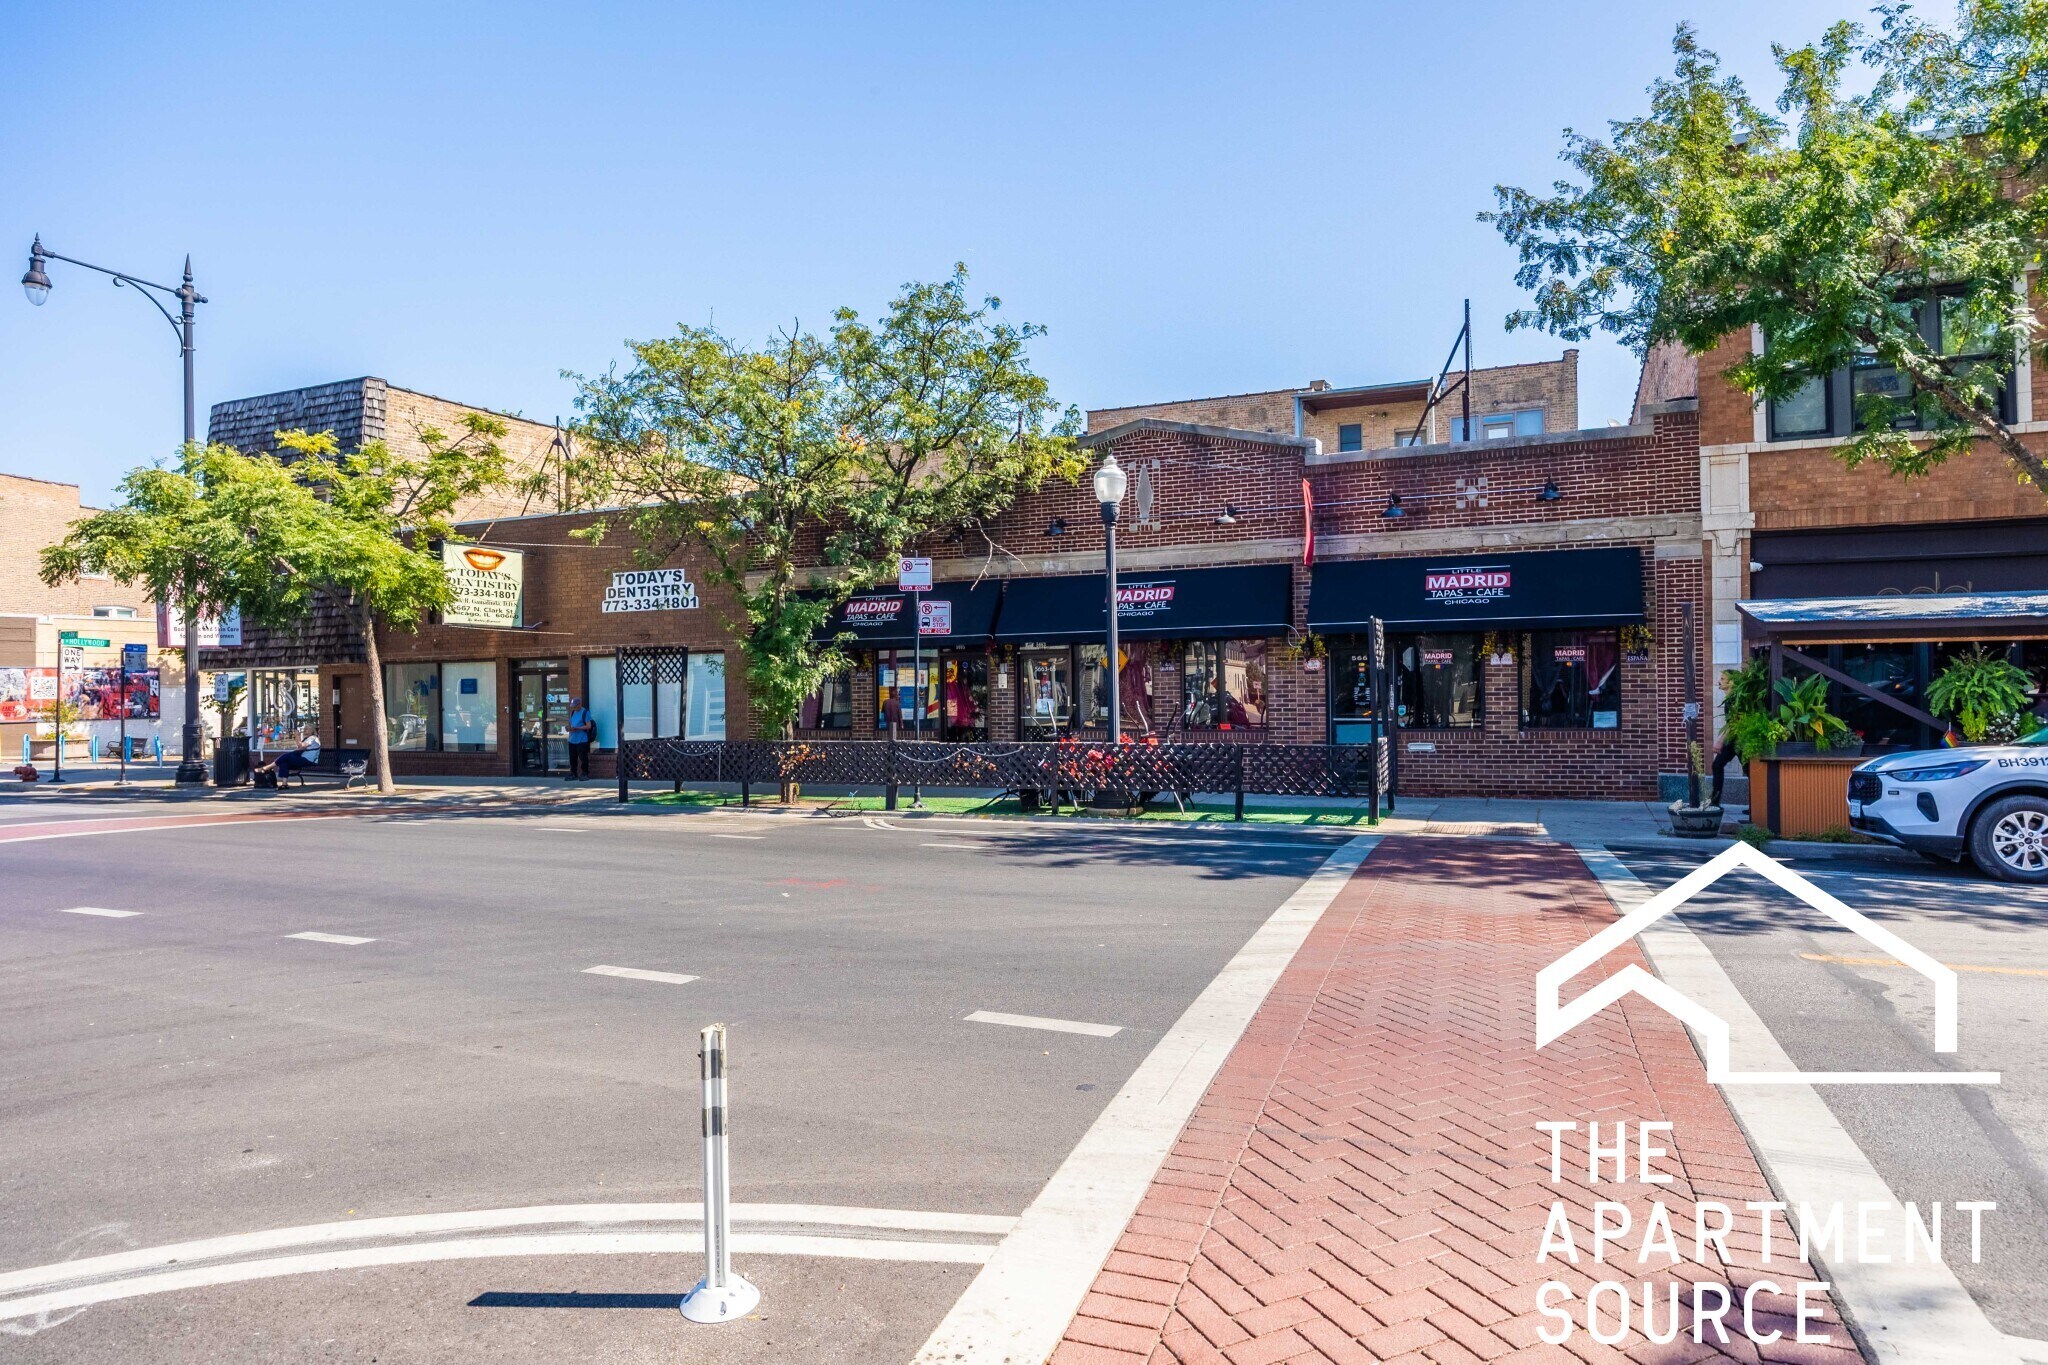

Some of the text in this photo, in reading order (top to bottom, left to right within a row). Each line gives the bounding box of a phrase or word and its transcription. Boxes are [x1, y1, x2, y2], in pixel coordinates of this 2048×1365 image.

[458, 568, 511, 580] TODAY'S
[615, 570, 683, 585] TODAY'S
[1428, 575, 1508, 588] MADRID
[608, 584, 691, 598] DENTISTRY
[1431, 589, 1463, 598] TAPAS
[1476, 588, 1504, 596] CAFE
[603, 597, 697, 611] 773-334-1801
[847, 602, 901, 613] MADRID
